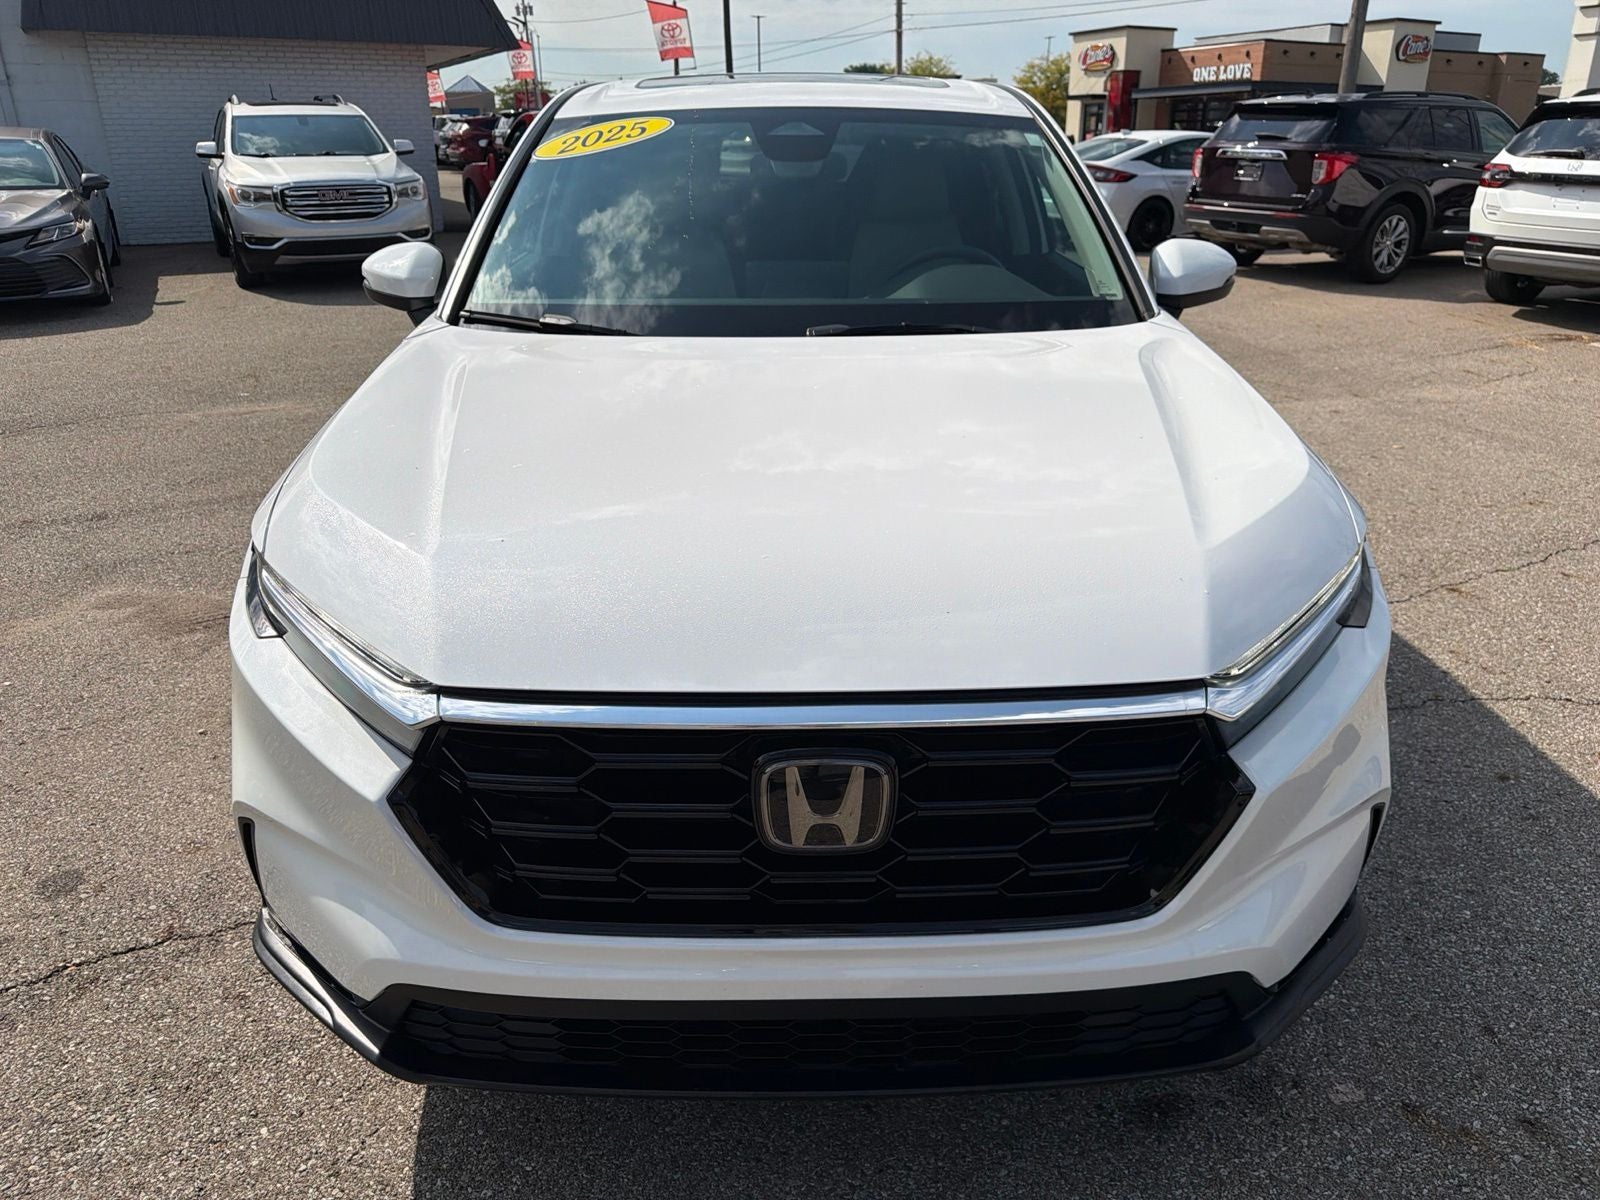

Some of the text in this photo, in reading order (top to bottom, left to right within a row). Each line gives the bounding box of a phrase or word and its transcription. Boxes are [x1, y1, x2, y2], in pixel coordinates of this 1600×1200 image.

[1193, 63, 1251, 82] ONE LOVE
[557, 120, 650, 155] 2025
[318, 189, 357, 200] GMC
